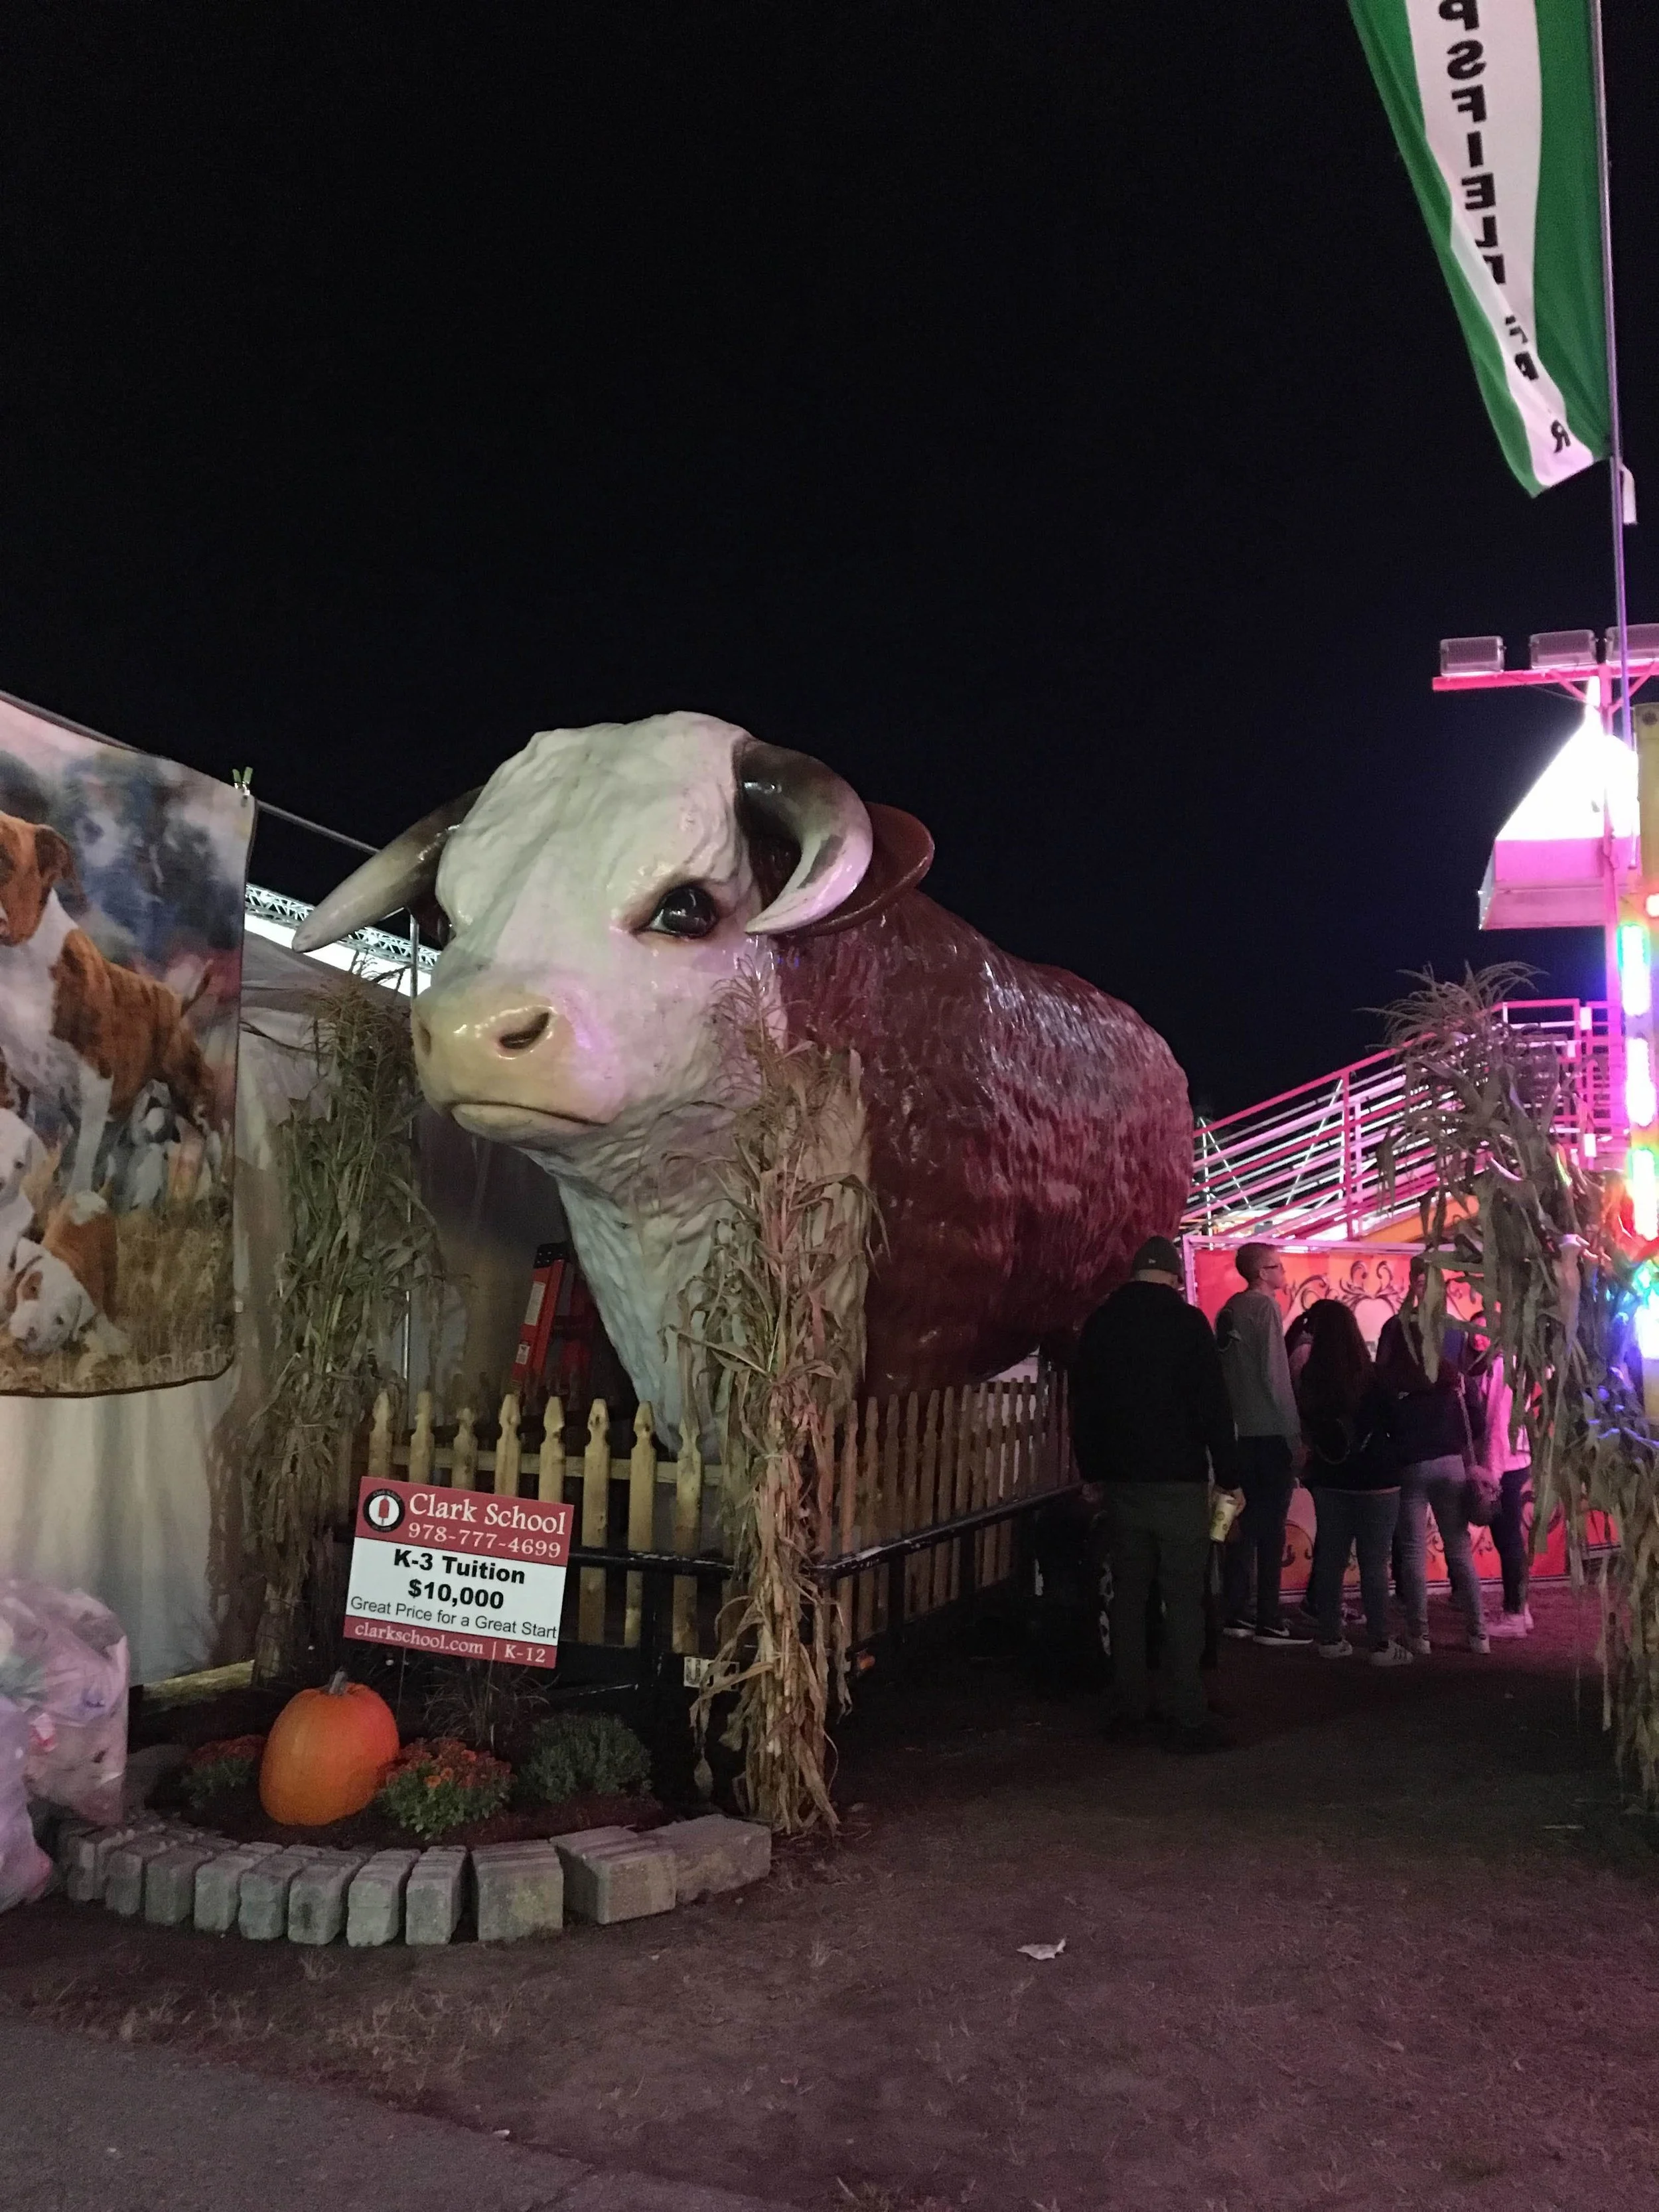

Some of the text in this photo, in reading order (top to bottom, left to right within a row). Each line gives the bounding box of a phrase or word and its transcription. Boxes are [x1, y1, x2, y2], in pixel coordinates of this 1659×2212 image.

[409, 1493, 566, 1535] Clark School
[408, 1522, 561, 1558] 978-777-4699
[394, 1548, 526, 1584] K-3 Tuition
[407, 1578, 504, 1609] $10,000
[350, 1595, 557, 1639] Great Price for a Great Start
[354, 1622, 547, 1663] clarkschool.com K-12
